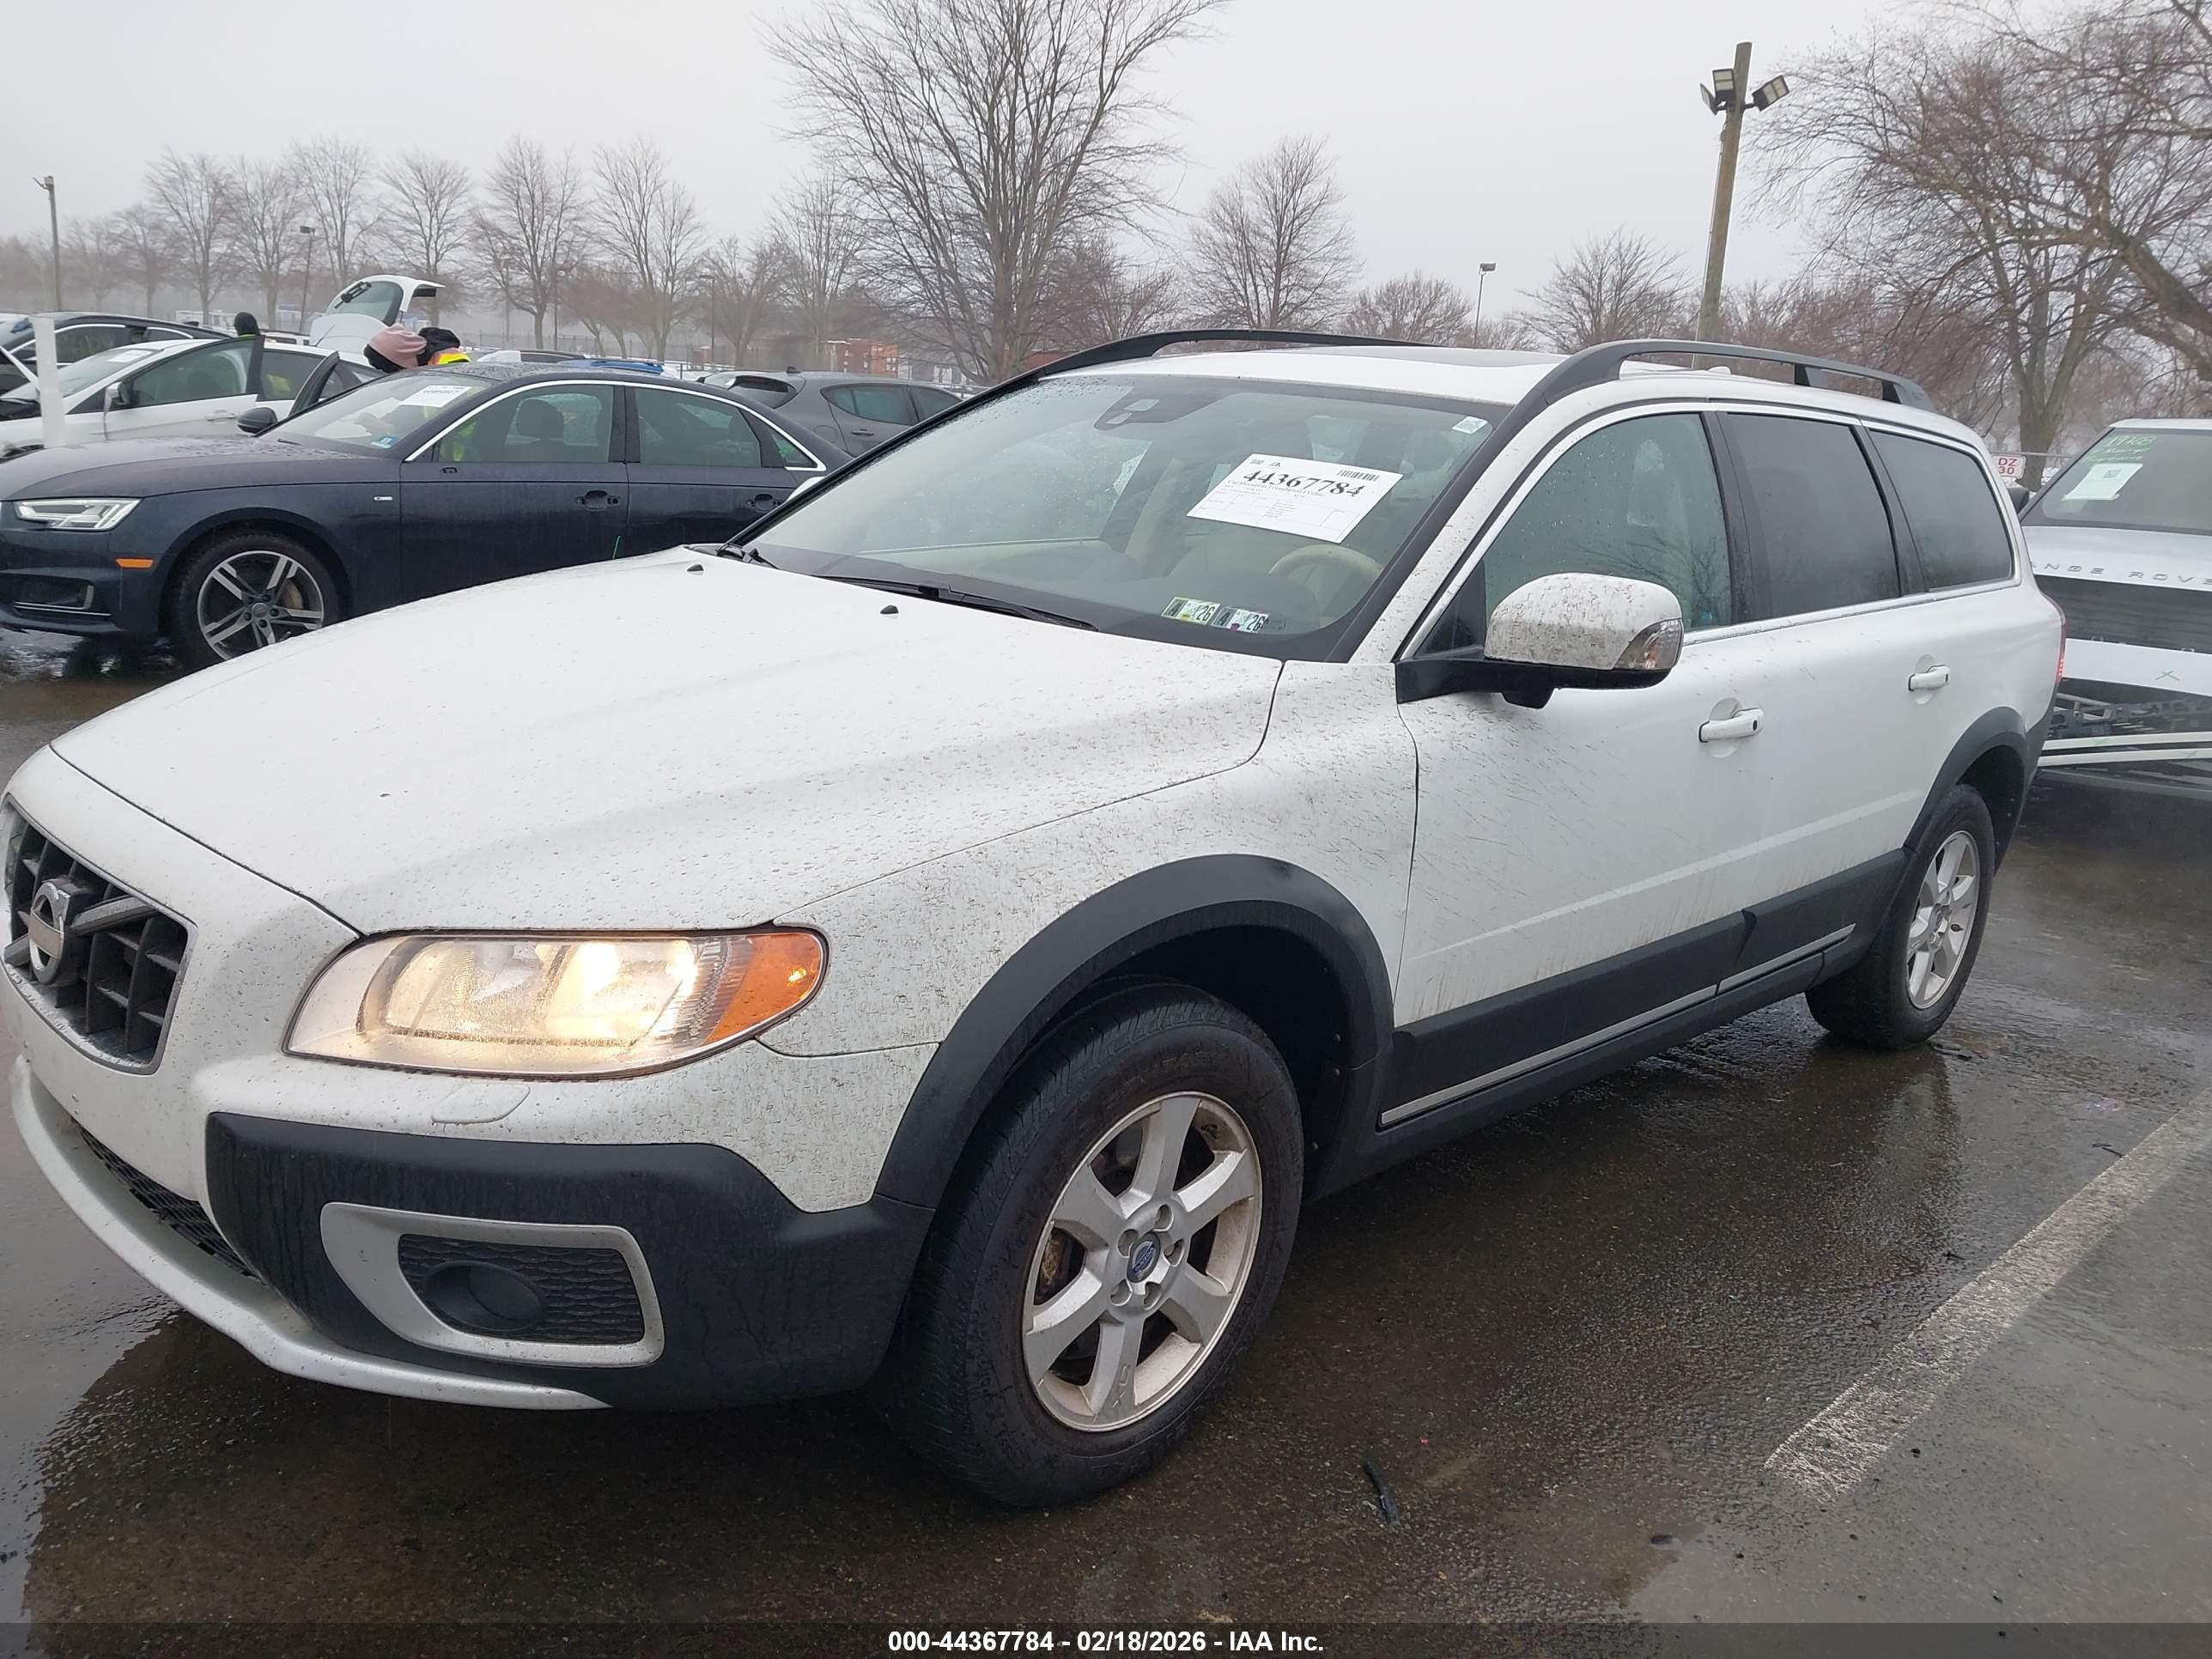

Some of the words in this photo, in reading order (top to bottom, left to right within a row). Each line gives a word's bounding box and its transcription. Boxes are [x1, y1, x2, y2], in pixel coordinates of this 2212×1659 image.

[1998, 458, 2018, 466] DZ
[1998, 466, 2014, 475] 30
[1243, 470, 1365, 497] 44367784
[2032, 562, 2104, 574] NGE
[1196, 605, 1216, 622] 26
[1246, 614, 1266, 632] 26
